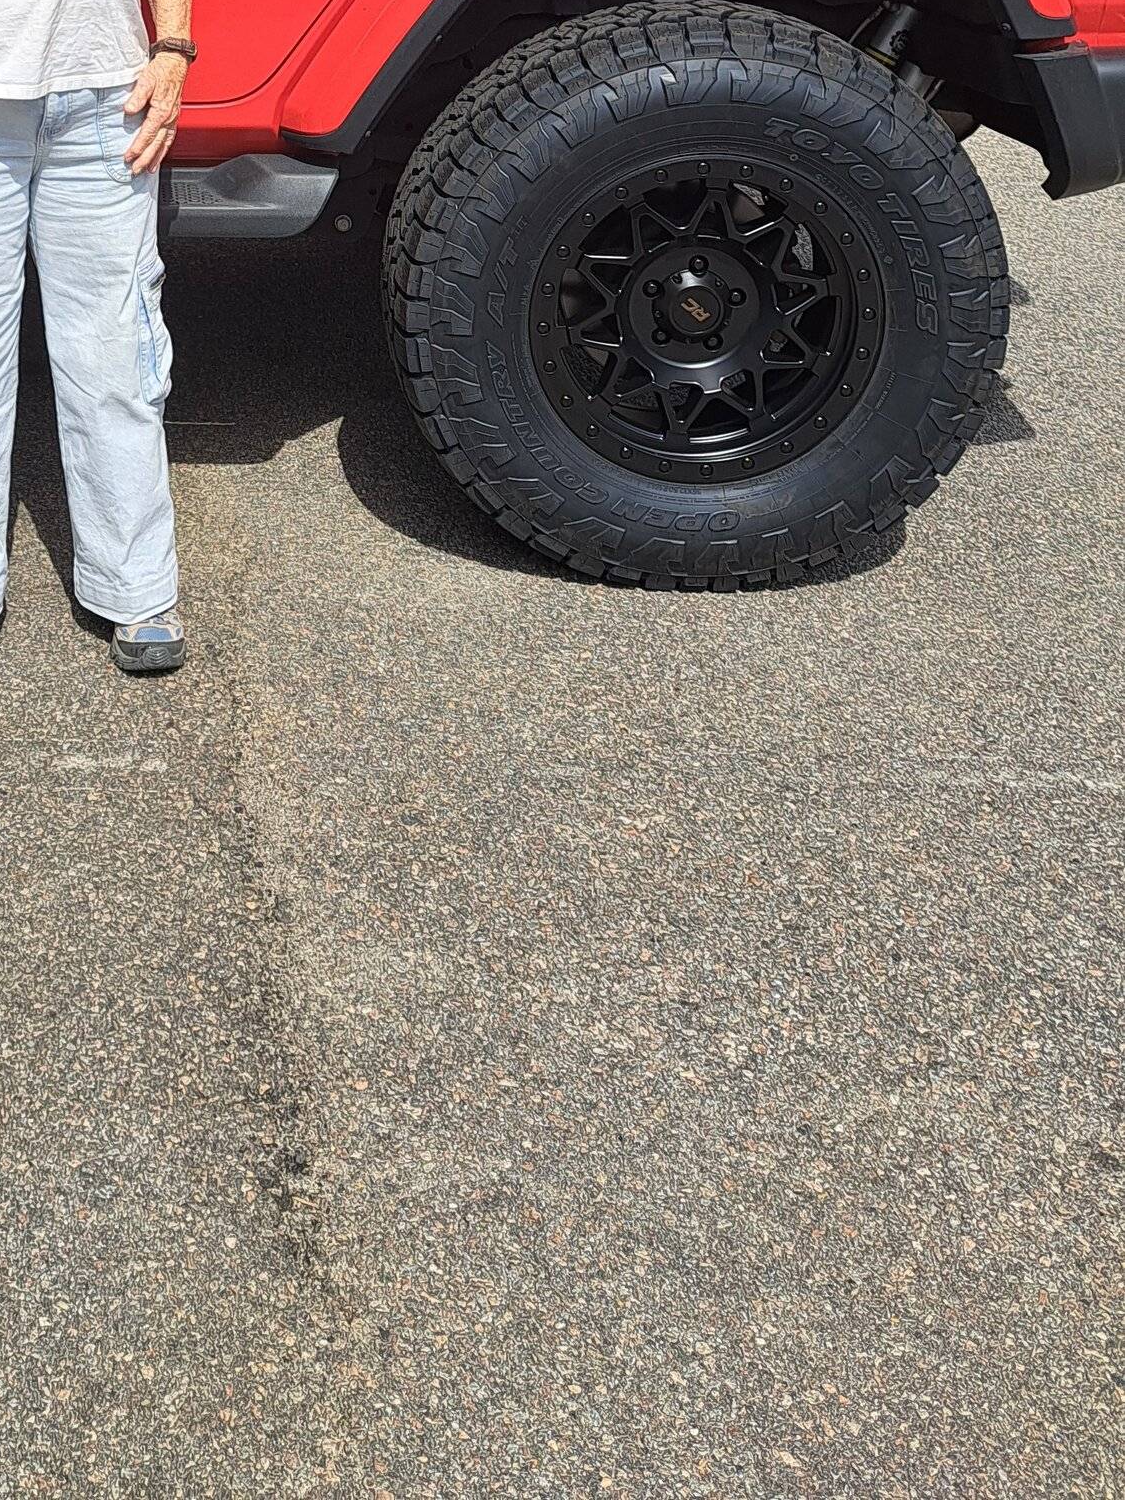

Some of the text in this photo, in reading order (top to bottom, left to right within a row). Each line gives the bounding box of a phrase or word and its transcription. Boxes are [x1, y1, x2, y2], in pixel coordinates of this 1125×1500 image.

[763, 117, 884, 190] TOYO
[877, 193, 939, 335] TIRES
[485, 339, 609, 504] COUNTRY
[610, 497, 740, 532] OPEN
